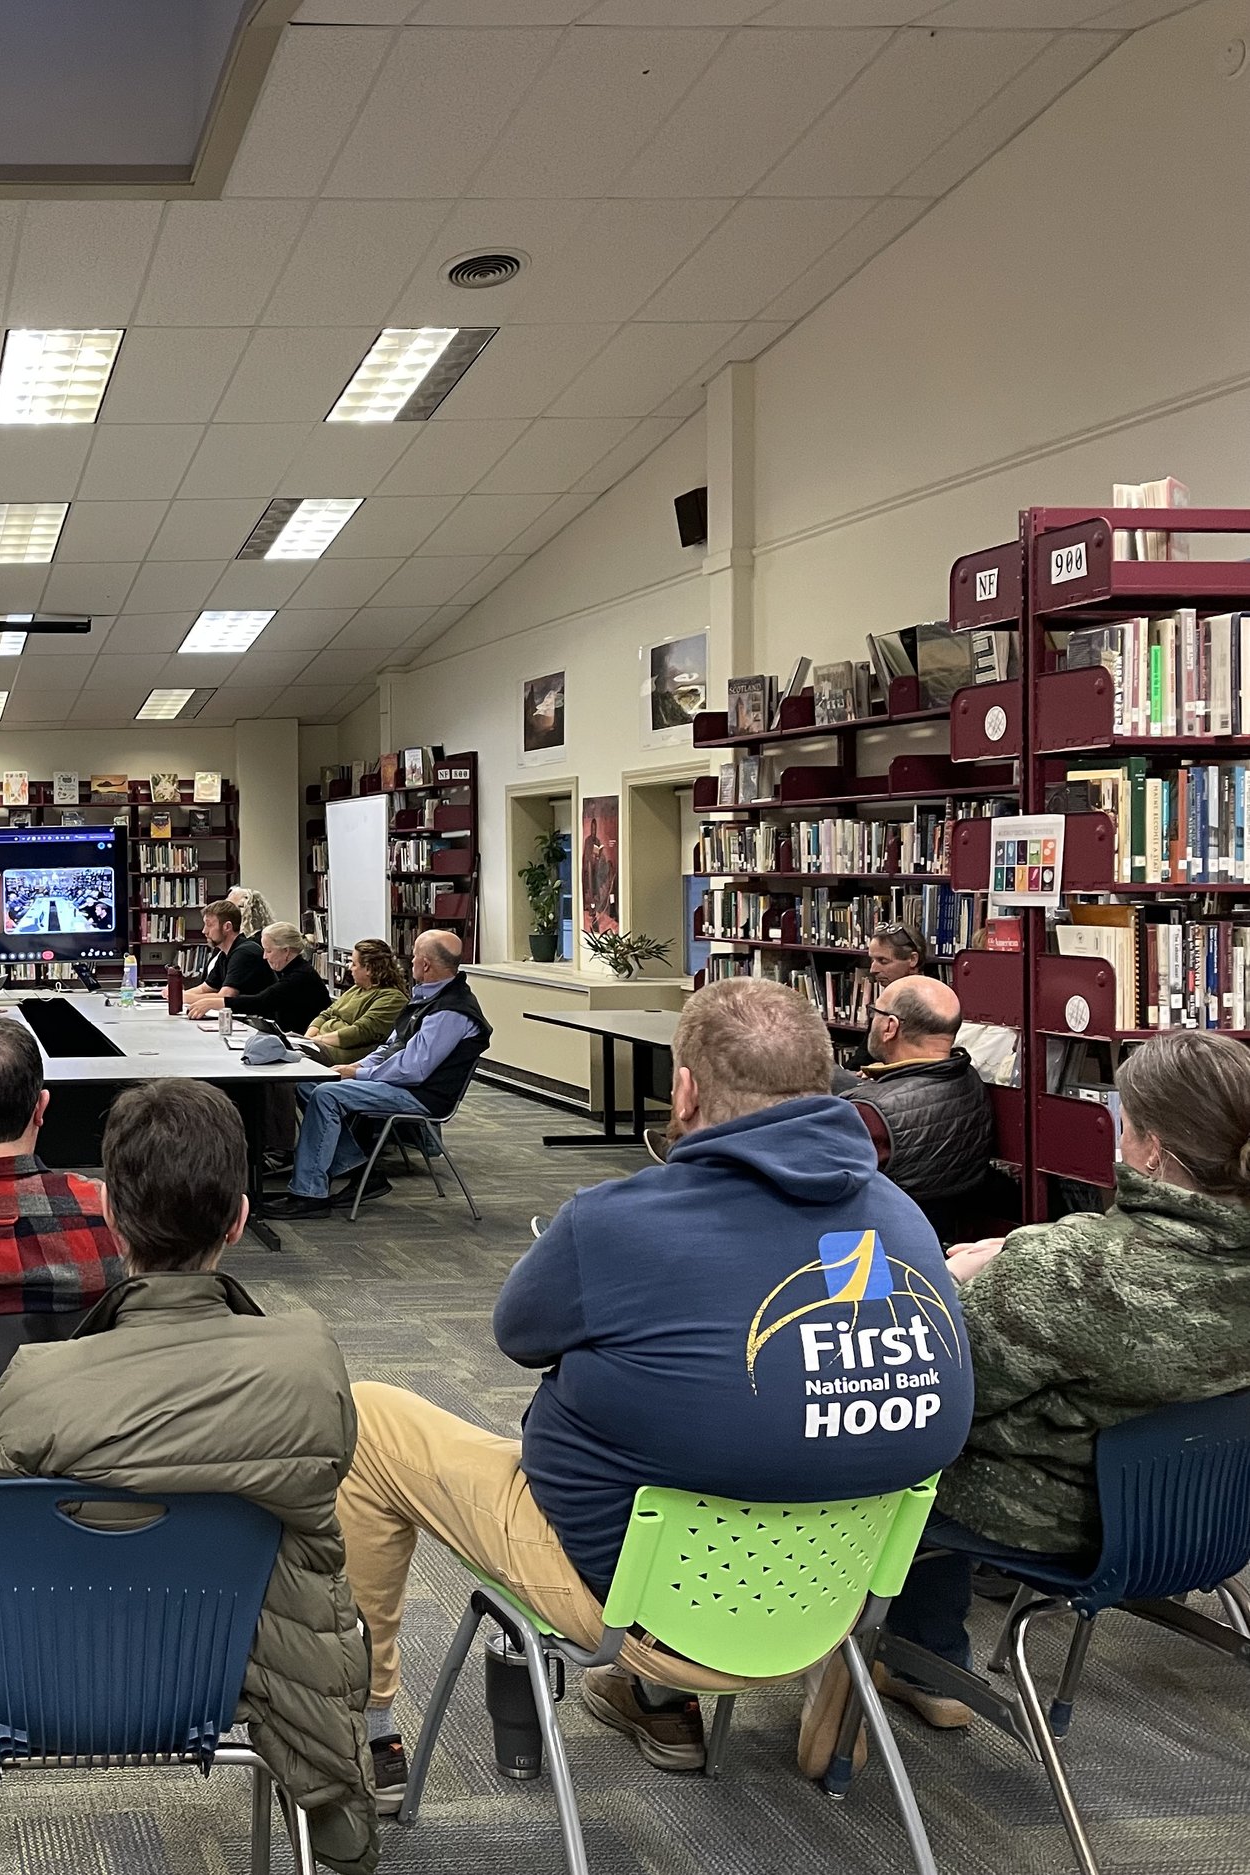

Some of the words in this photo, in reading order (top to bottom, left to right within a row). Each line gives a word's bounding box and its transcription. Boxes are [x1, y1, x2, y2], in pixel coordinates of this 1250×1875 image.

[1055, 547, 1083, 578] 900
[979, 573, 996, 598] NF
[729, 683, 762, 694] SCOTLAND
[440, 770, 449, 778] NF
[800, 1315, 935, 1372] First
[805, 1373, 890, 1396] National
[895, 1367, 940, 1390] Bank
[804, 1393, 941, 1438] HOOP
